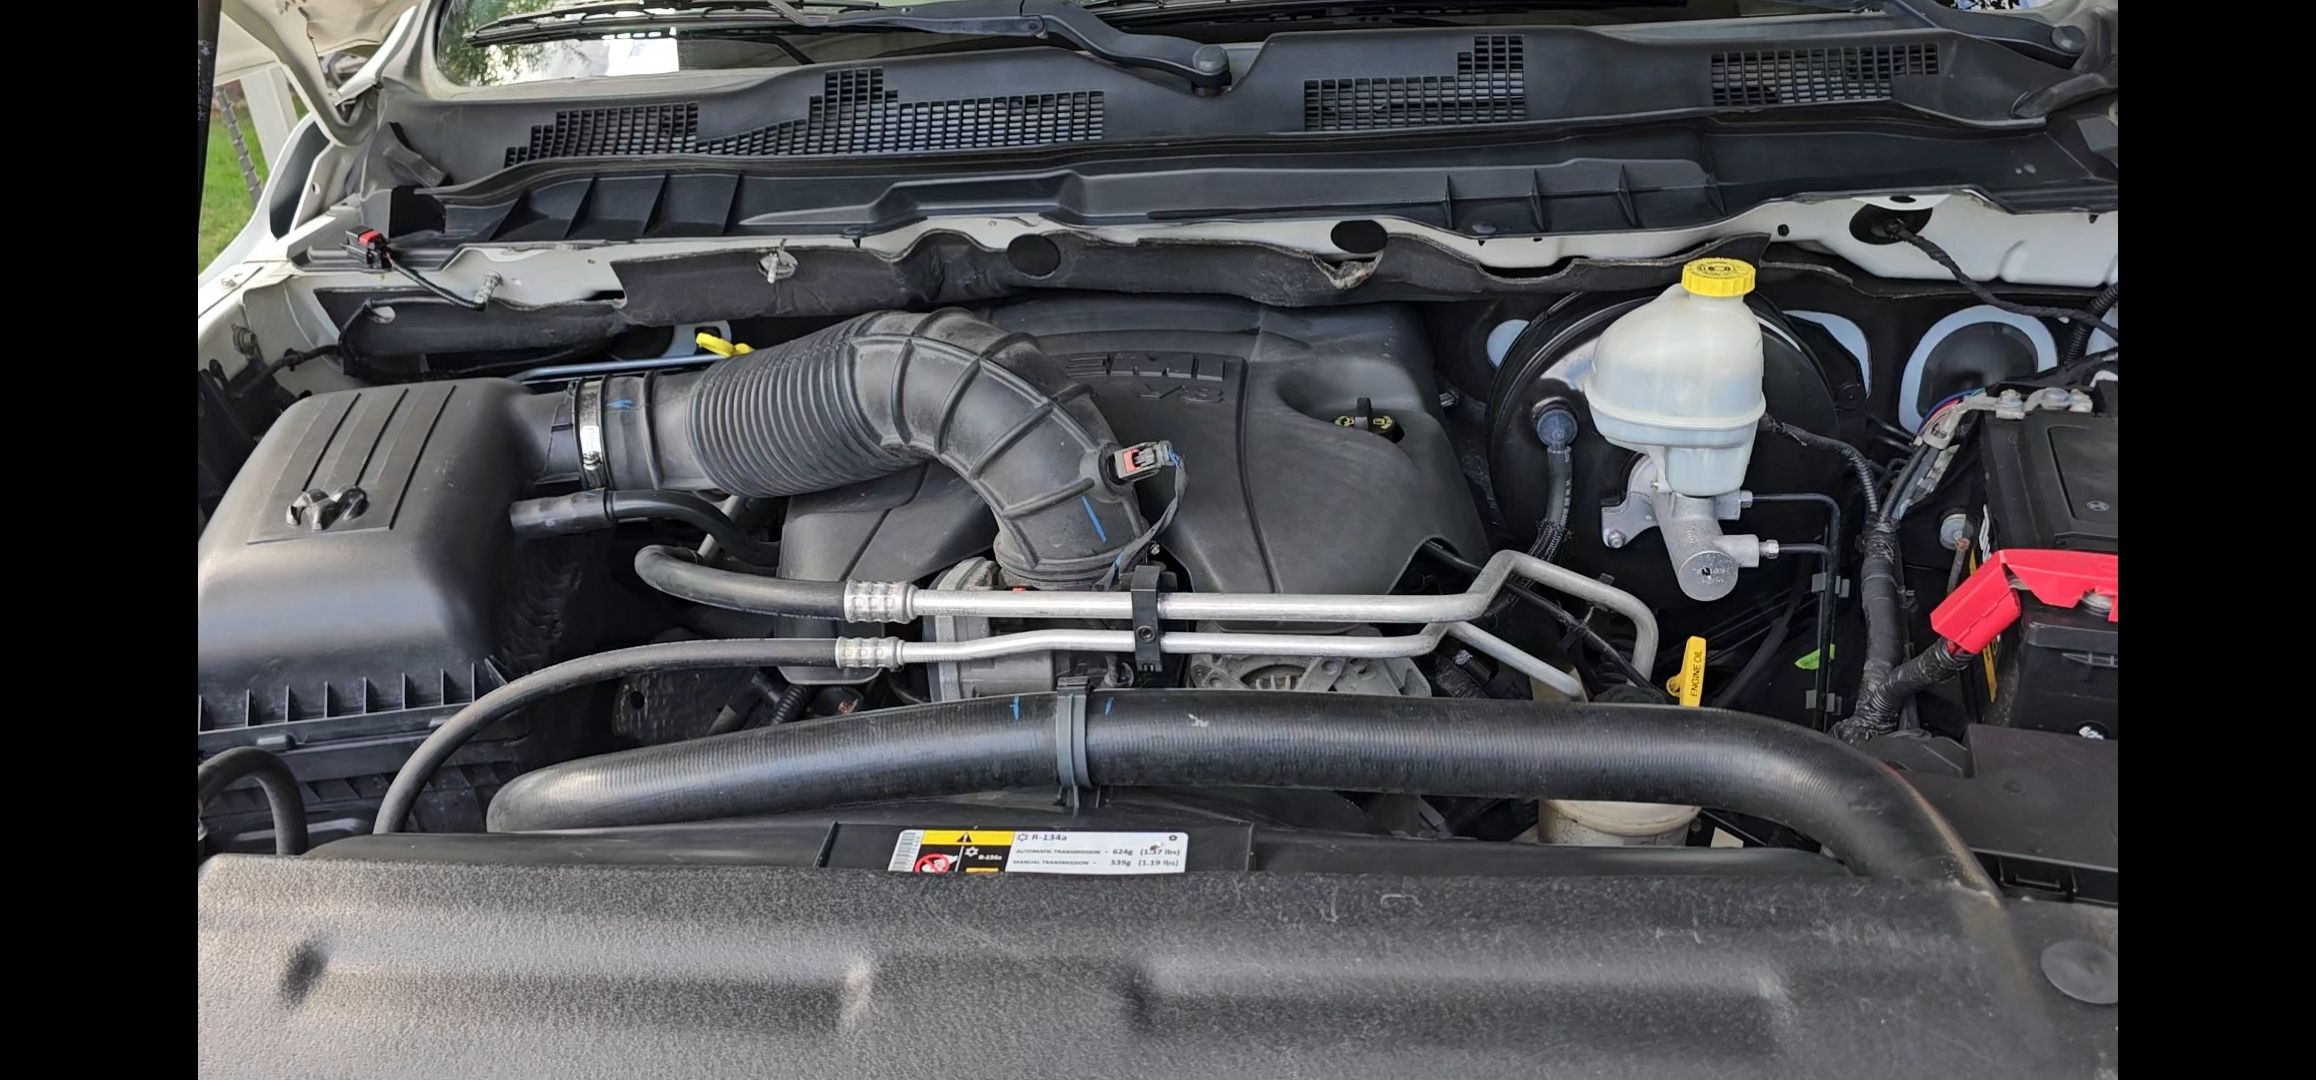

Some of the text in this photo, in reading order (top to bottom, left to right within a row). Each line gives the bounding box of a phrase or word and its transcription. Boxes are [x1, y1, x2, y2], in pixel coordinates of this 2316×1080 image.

[1066, 352, 1225, 382] EMI
[1690, 650, 1703, 697] ENGINE OIL
[1031, 833, 1068, 842] R-134a
[1112, 848, 1134, 857] 624g
[1164, 848, 1180, 856] lbs)
[1110, 859, 1132, 867] 539g
[1138, 859, 1161, 867] (1.19
[1162, 859, 1179, 867] lbs)
